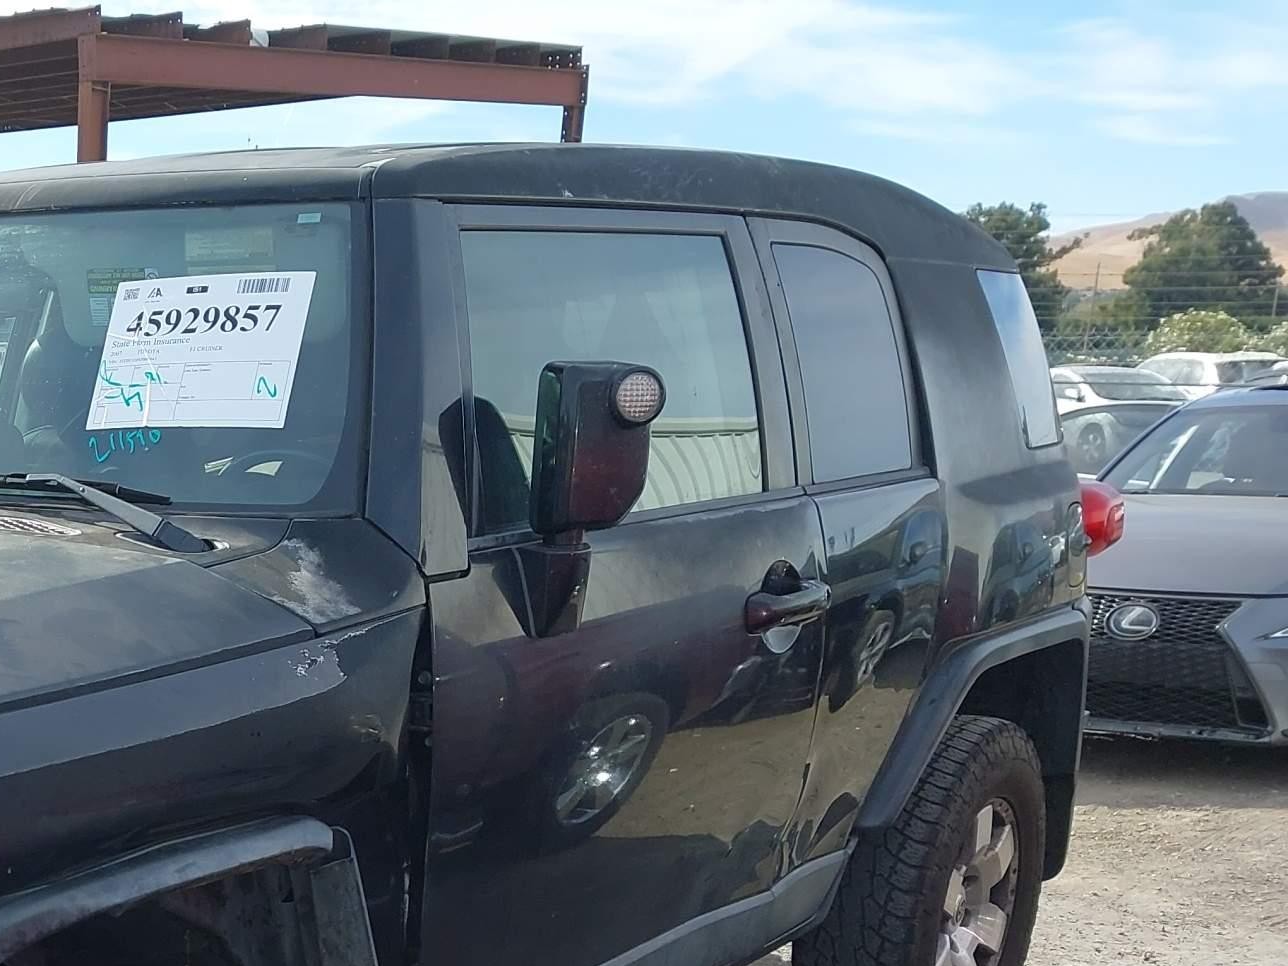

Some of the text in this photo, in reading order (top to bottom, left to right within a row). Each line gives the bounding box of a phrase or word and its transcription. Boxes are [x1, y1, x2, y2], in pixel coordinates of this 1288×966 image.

[126, 304, 283, 337] 45929857
[112, 341, 131, 349] State
[153, 337, 191, 346] Insurance
